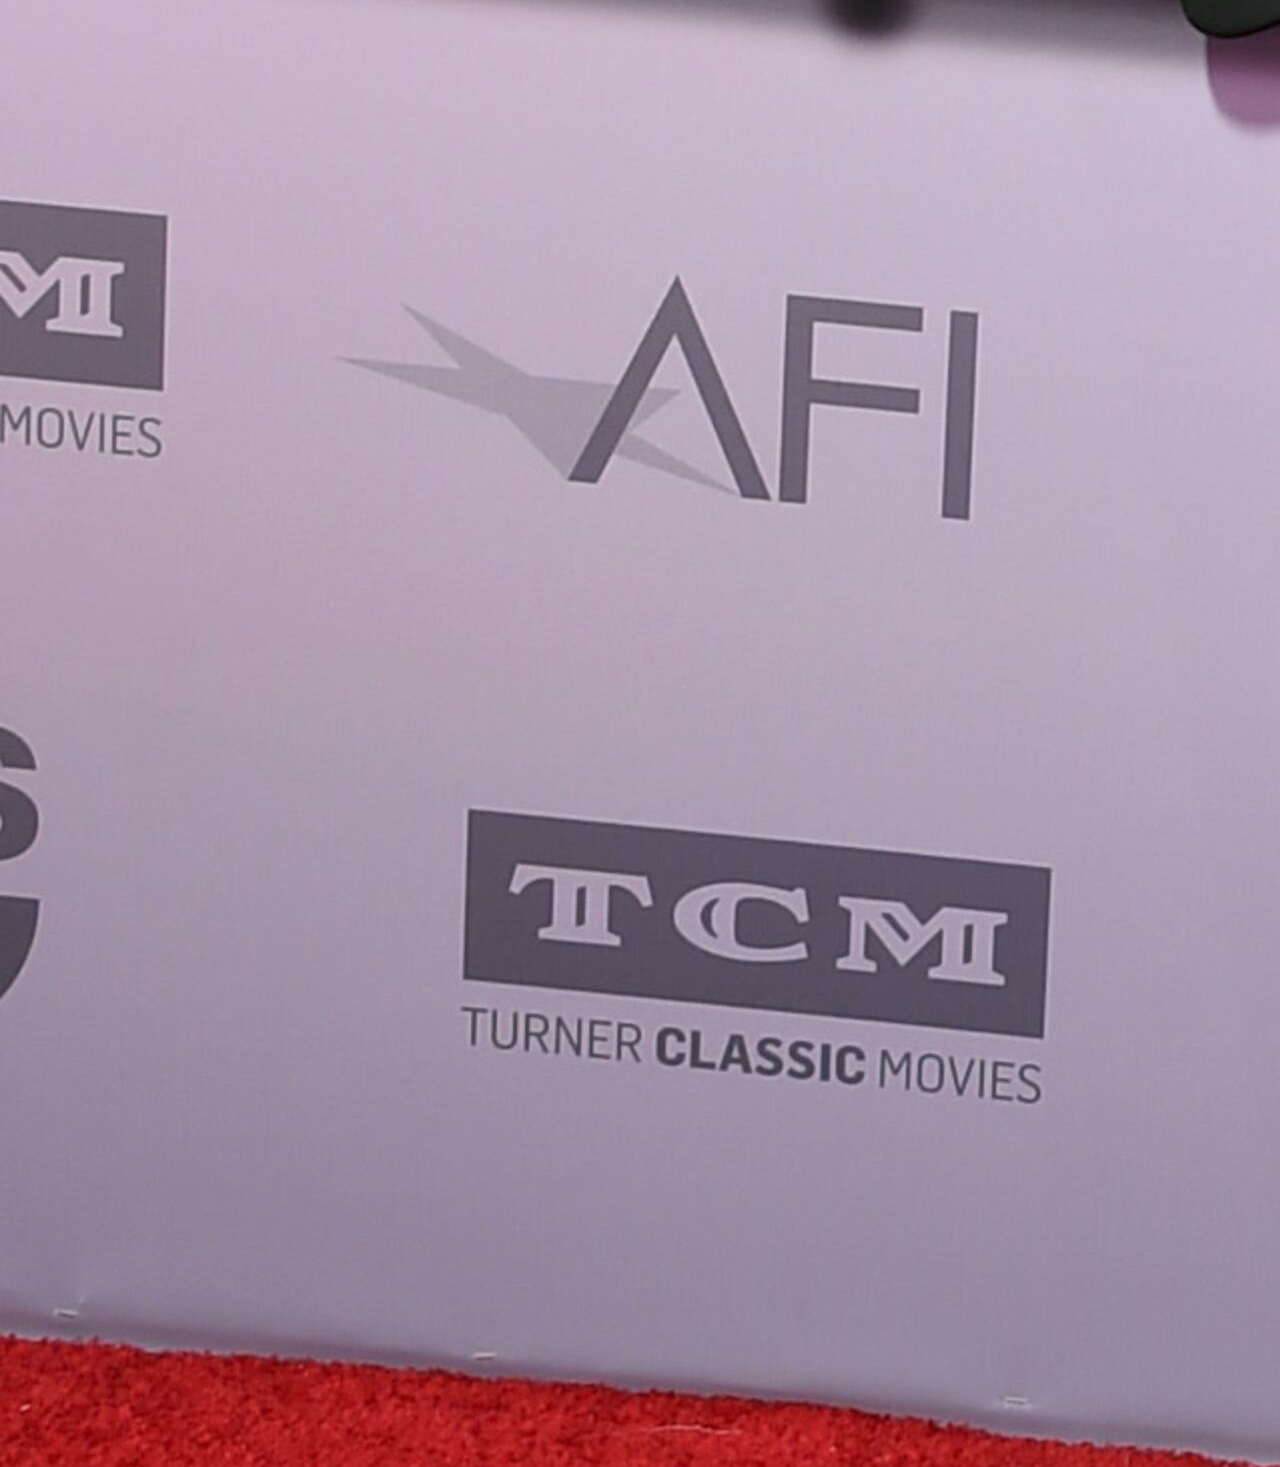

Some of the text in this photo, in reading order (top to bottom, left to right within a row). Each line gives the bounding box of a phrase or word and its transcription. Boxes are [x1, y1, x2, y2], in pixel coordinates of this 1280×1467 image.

[0, 403, 163, 459] MOVIES
[567, 274, 979, 521] AFI
[508, 863, 1008, 986] TCM
[461, 1006, 1043, 1105] TURNER CLASSIC MOVIES
